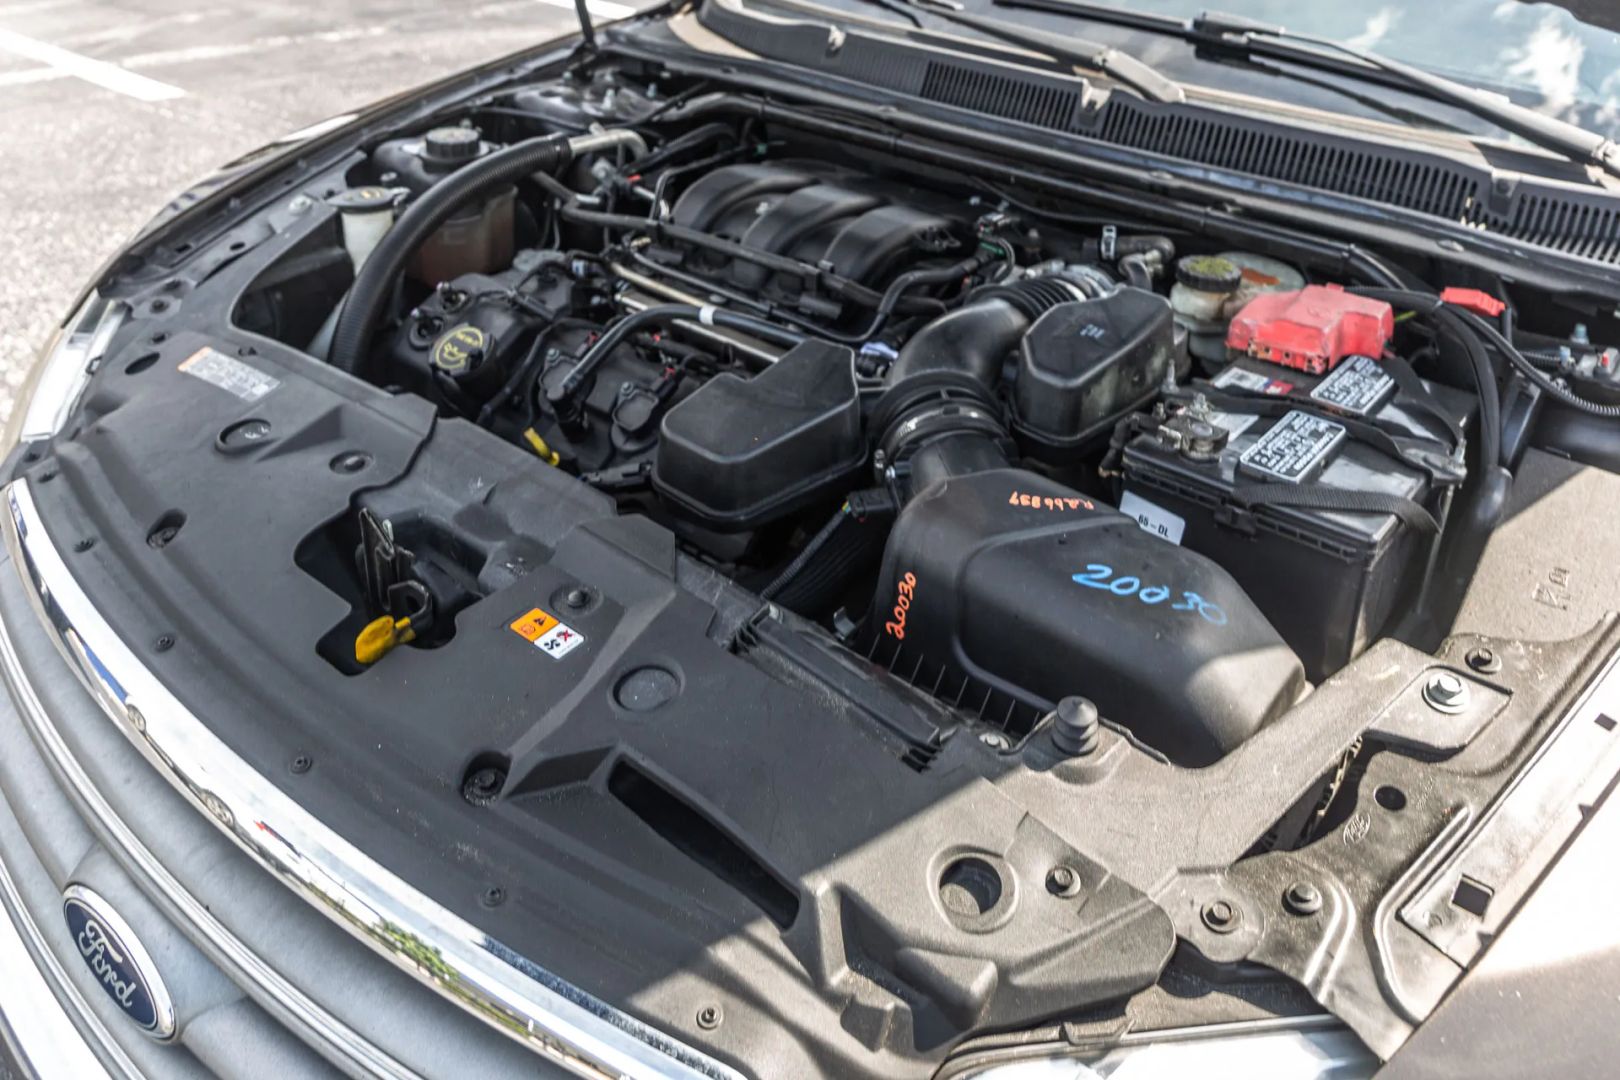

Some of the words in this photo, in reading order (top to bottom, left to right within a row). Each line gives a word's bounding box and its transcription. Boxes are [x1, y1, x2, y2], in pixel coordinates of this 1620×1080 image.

[885, 571, 917, 640] 20030
[1071, 563, 1228, 625] 20030
[78, 919, 137, 1008] Ford
